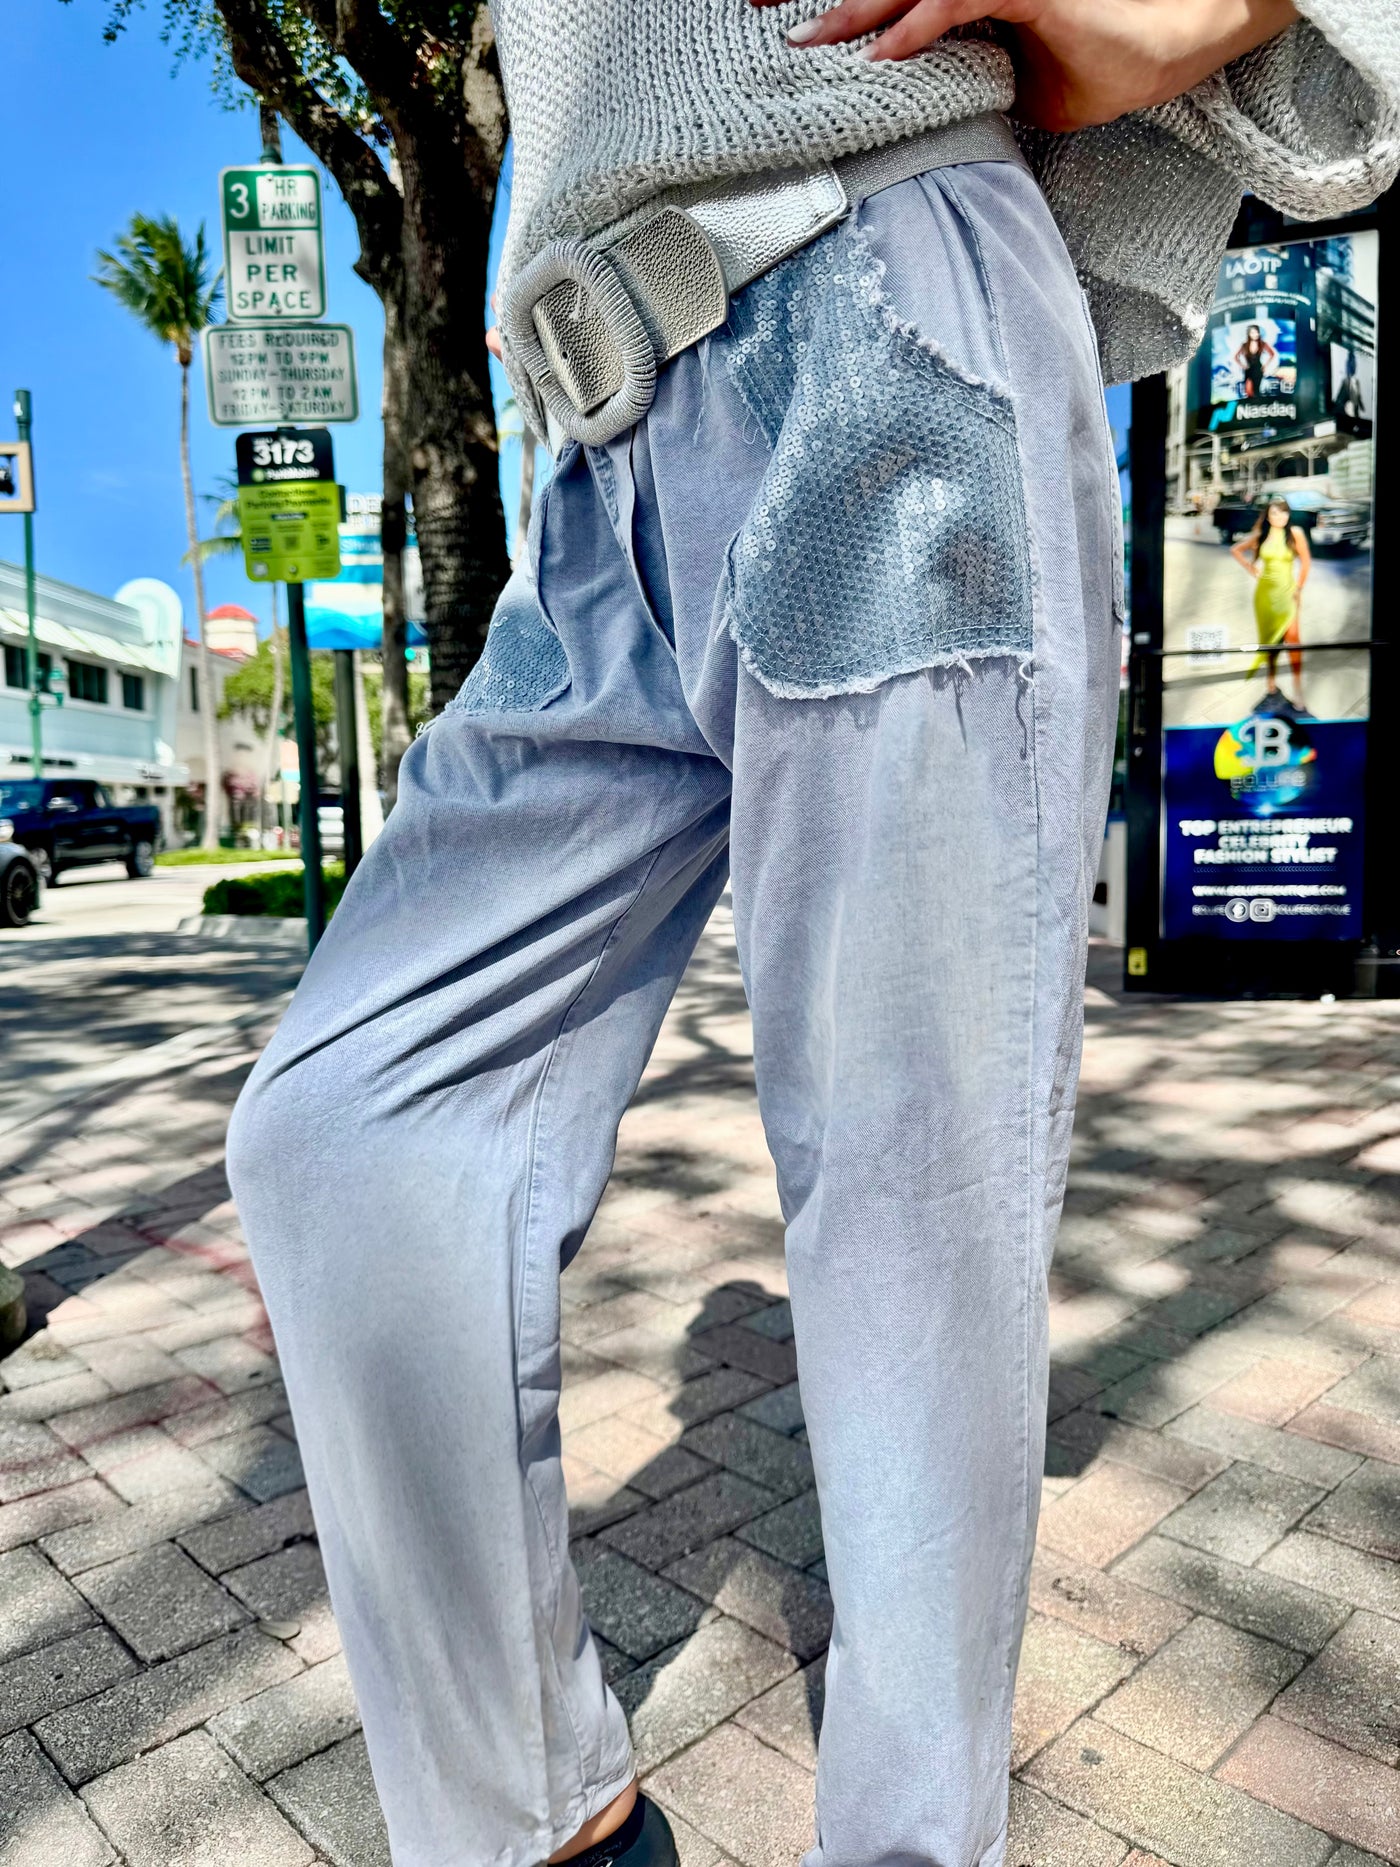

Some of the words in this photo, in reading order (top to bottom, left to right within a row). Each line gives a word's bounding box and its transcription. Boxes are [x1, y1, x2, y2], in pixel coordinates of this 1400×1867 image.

[229, 182, 249, 219] 3
[275, 178, 298, 197] HR
[262, 202, 316, 221] PARKING
[244, 236, 295, 255] LIMIT
[246, 264, 298, 283] PER
[236, 290, 312, 310] SPACE
[217, 333, 257, 349] FEES
[264, 332, 340, 348] REQUIRED
[1236, 401, 1297, 421] Nasdaq
[252, 440, 315, 466] 3173
[1179, 820, 1216, 837] TOP
[1218, 817, 1353, 835] ENTREPRENEUR
[1218, 833, 1311, 850] CELEBRITY
[1194, 848, 1269, 864] FASHION
[1270, 847, 1338, 864] STYLIST
